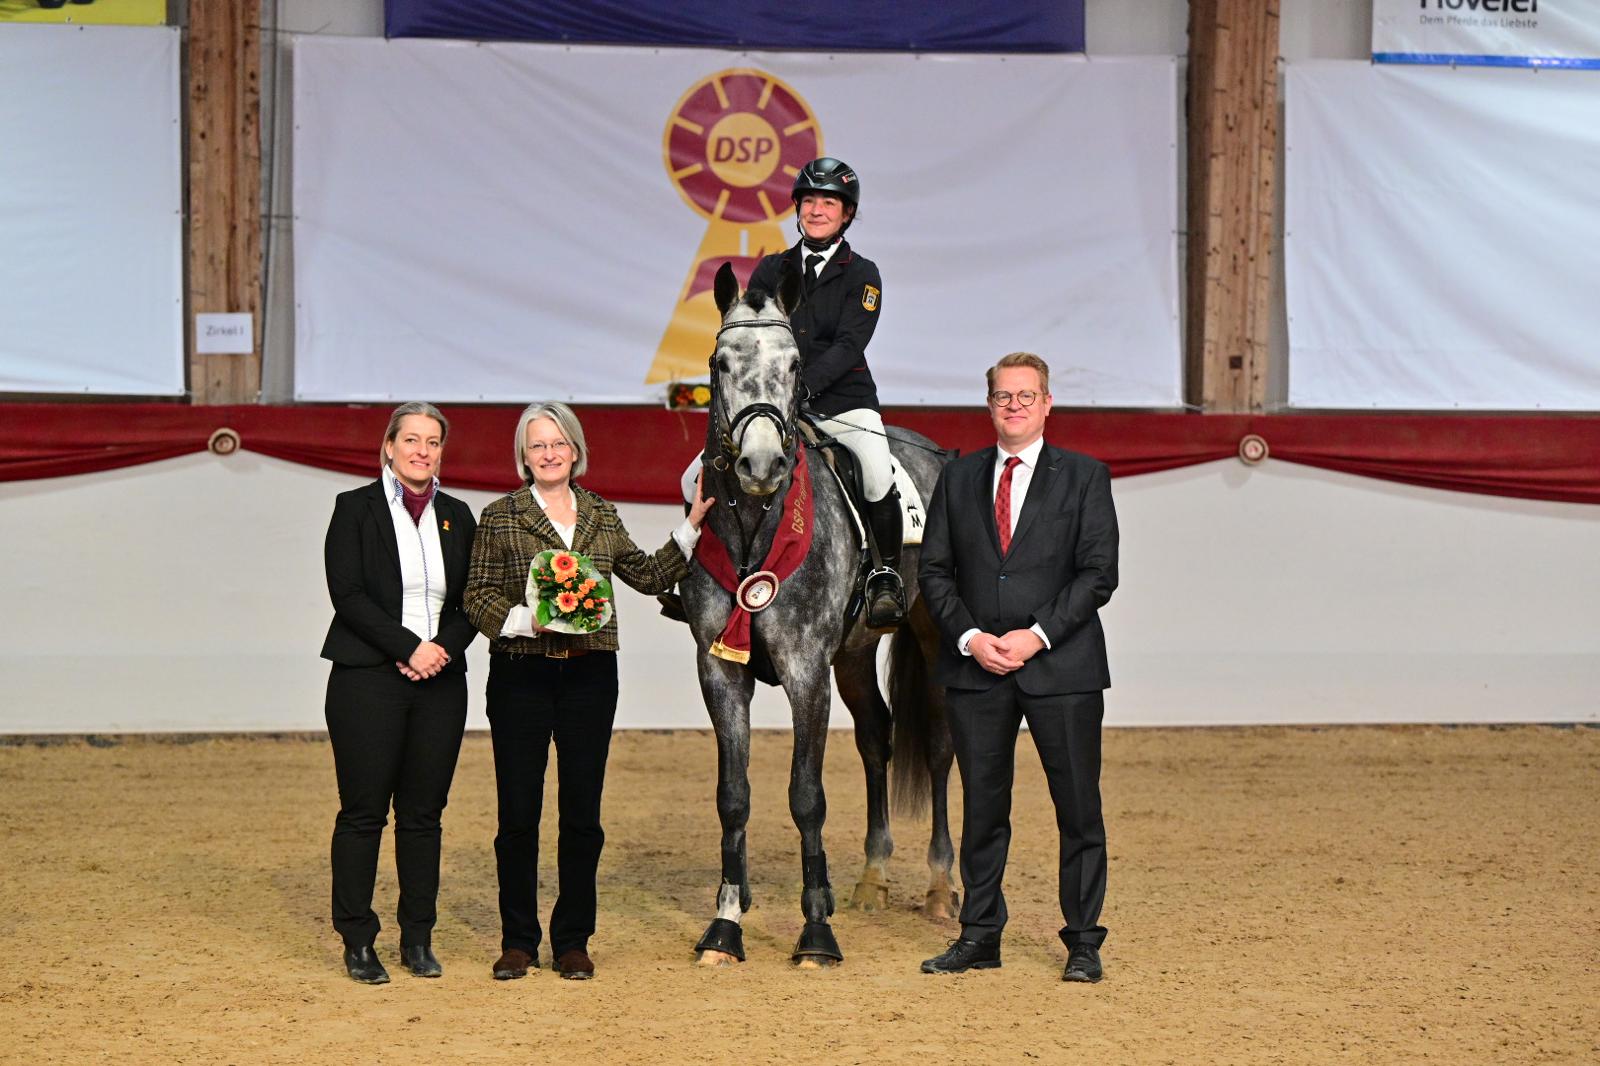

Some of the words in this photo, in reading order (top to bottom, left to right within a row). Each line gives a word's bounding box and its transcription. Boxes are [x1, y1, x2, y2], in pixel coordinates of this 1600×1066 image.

[1419, 14, 1444, 25] Dem
[1447, 15, 1478, 26] Pferde
[1481, 16, 1498, 27] das
[1500, 17, 1539, 28] Liebste
[713, 136, 774, 163] DSP
[206, 324, 238, 337] Zirkel
[791, 508, 805, 535] DSP
